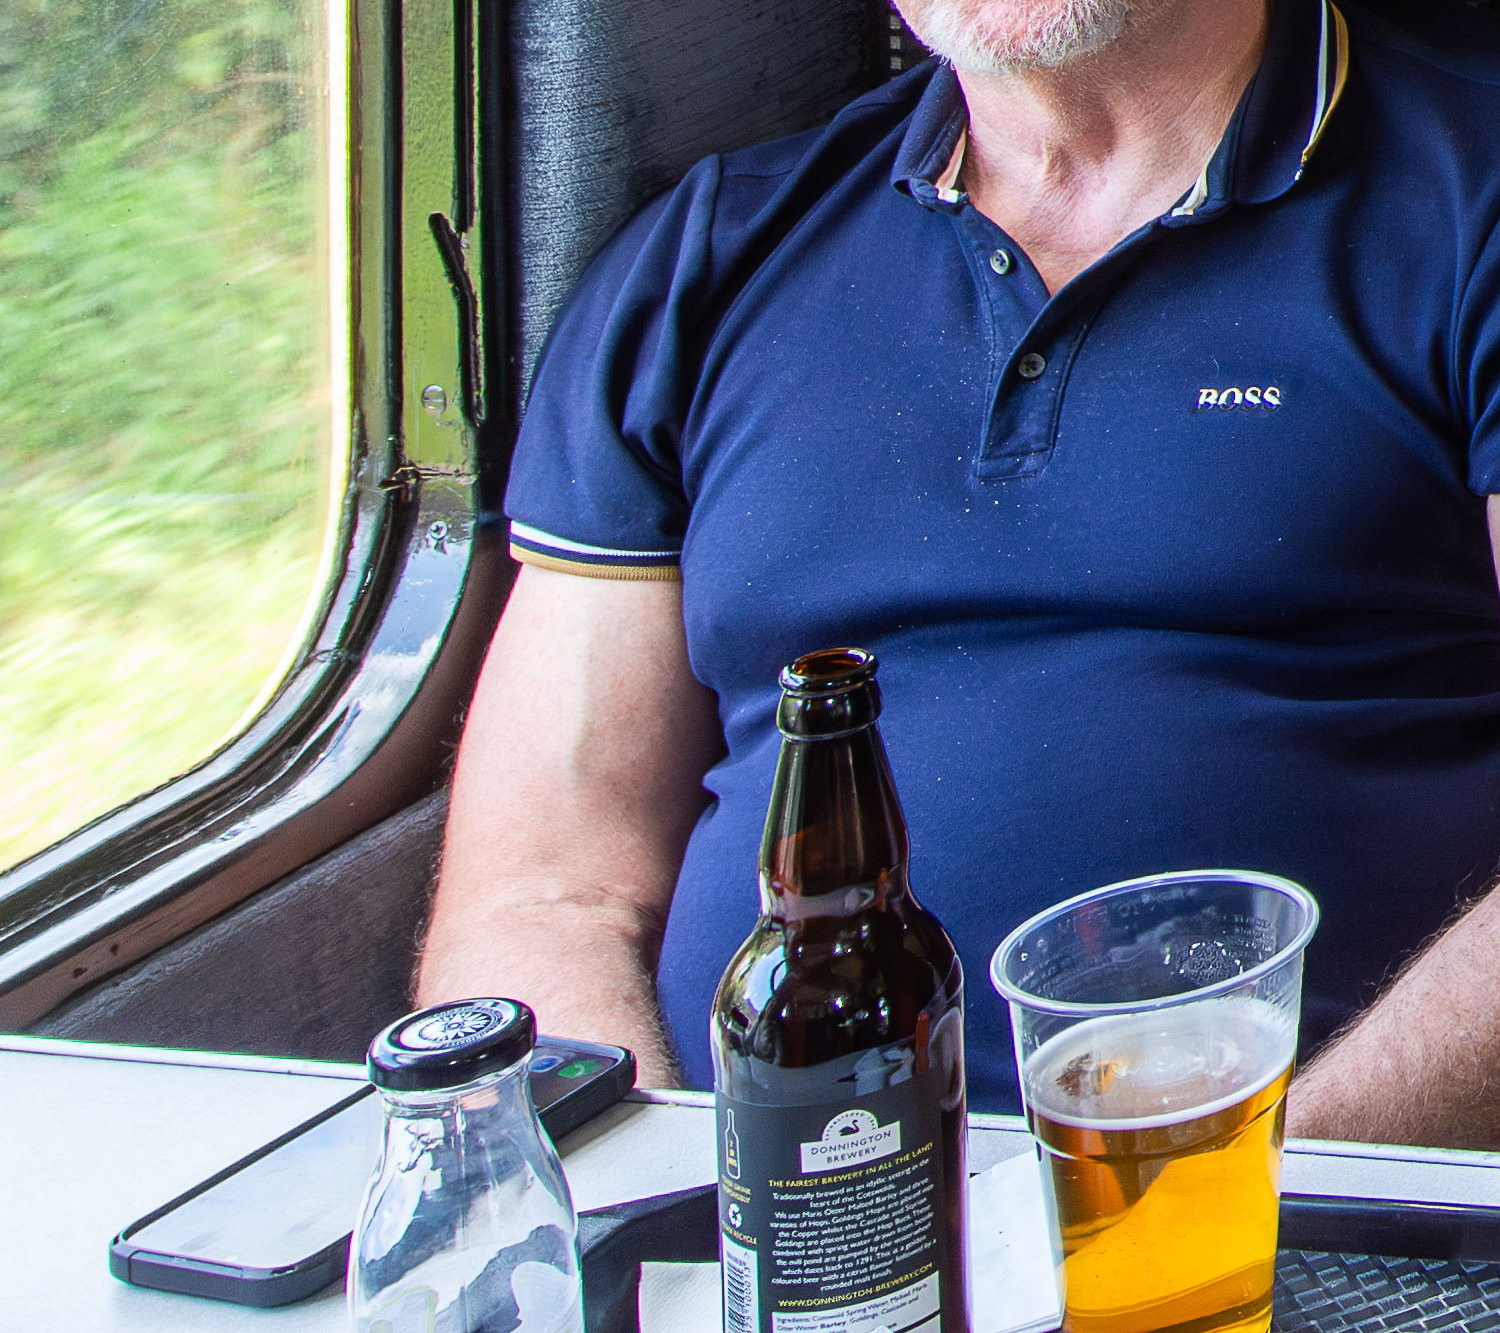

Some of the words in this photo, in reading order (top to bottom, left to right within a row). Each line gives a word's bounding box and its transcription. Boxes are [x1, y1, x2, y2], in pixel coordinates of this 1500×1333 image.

[1197, 386, 1284, 411] BOSS
[811, 1130, 892, 1156] DONNINGTON
[826, 1145, 878, 1164] BREWERY
[768, 1179, 784, 1188] THE
[786, 1178, 819, 1187] FAIREST
[821, 1170, 864, 1185] BREWERY
[866, 1166, 877, 1175] IN
[895, 1153, 911, 1165] THE
